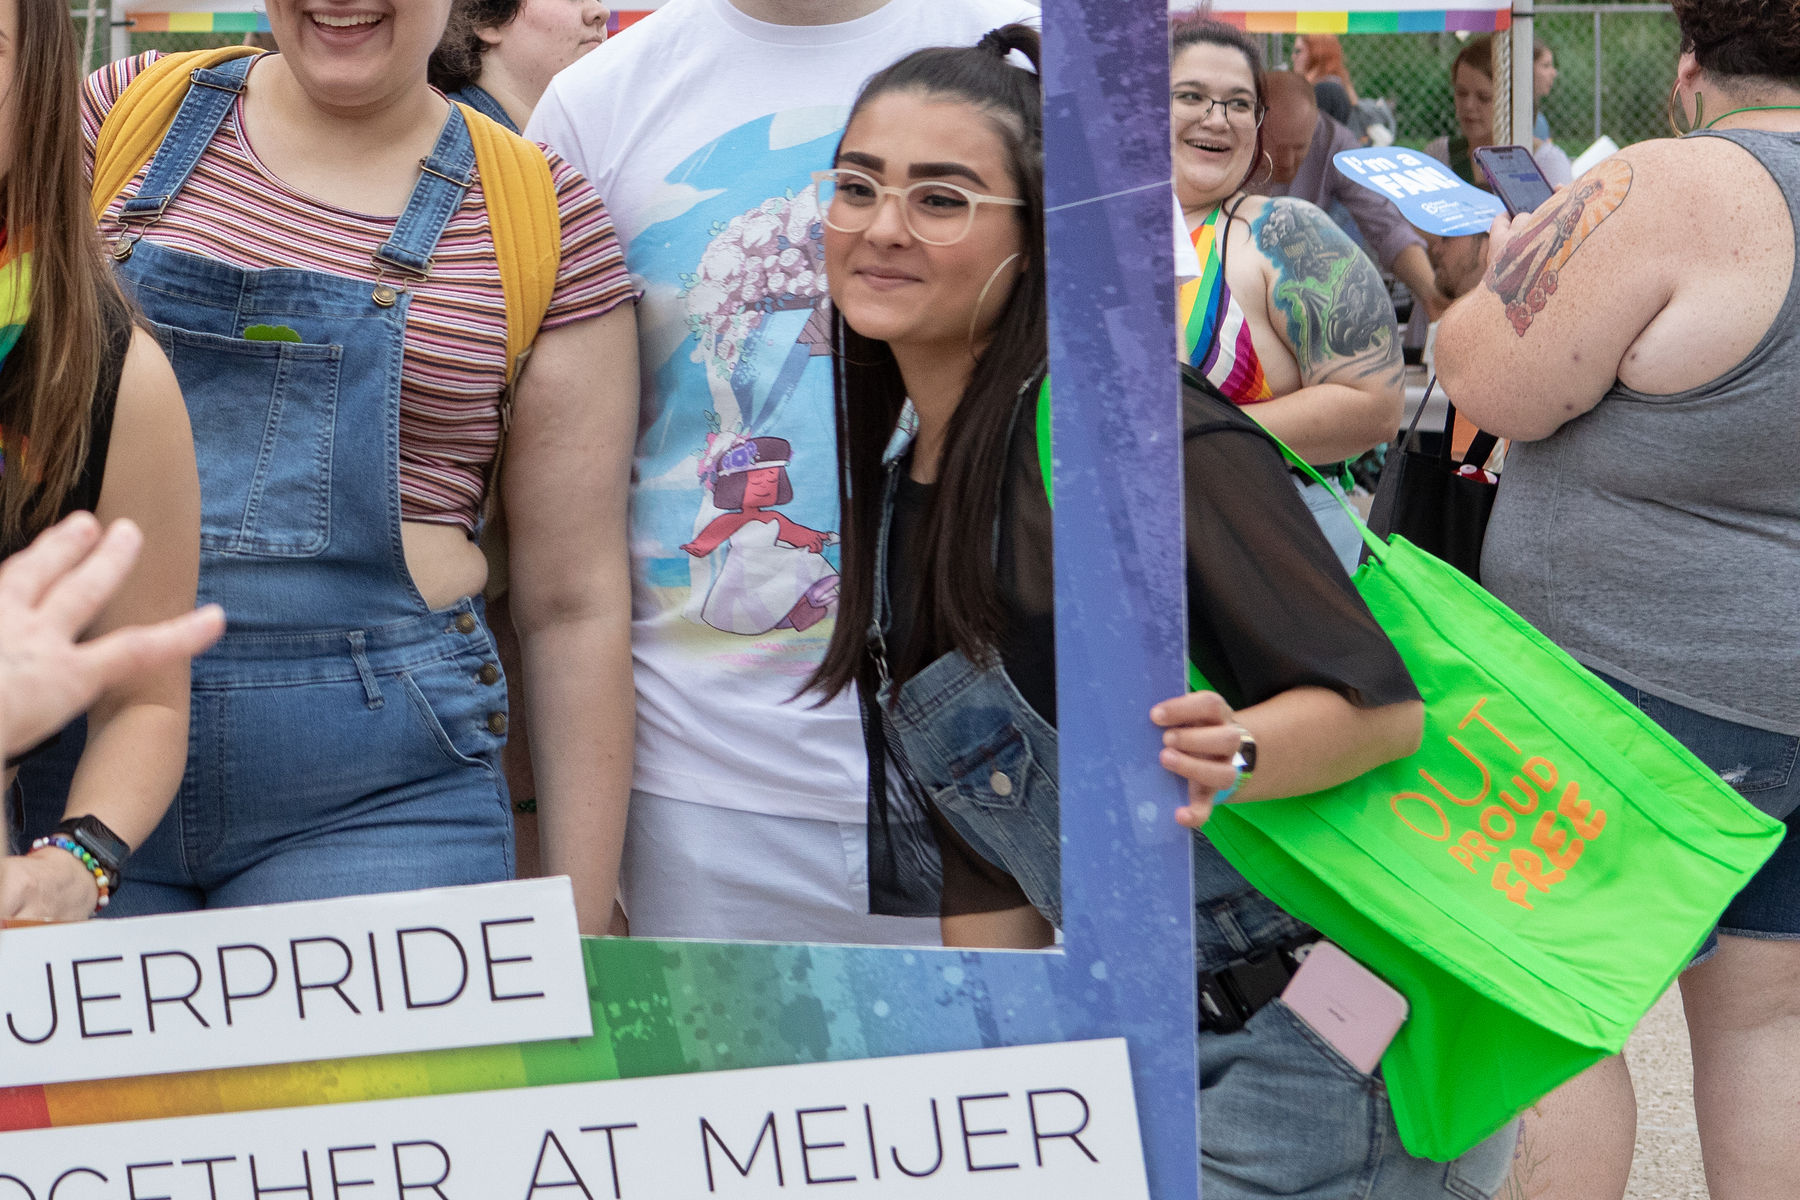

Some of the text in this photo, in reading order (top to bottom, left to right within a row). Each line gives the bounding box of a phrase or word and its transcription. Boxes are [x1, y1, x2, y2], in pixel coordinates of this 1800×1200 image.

[1341, 153, 1422, 175] I'm a
[1368, 166, 1461, 199] FAN!
[1390, 697, 1522, 842] OUT
[1447, 756, 1559, 874] PROUD
[1490, 781, 1607, 911] FREE
[525, 1122, 638, 1200] AT
[698, 1086, 1100, 1193] MEIJER
